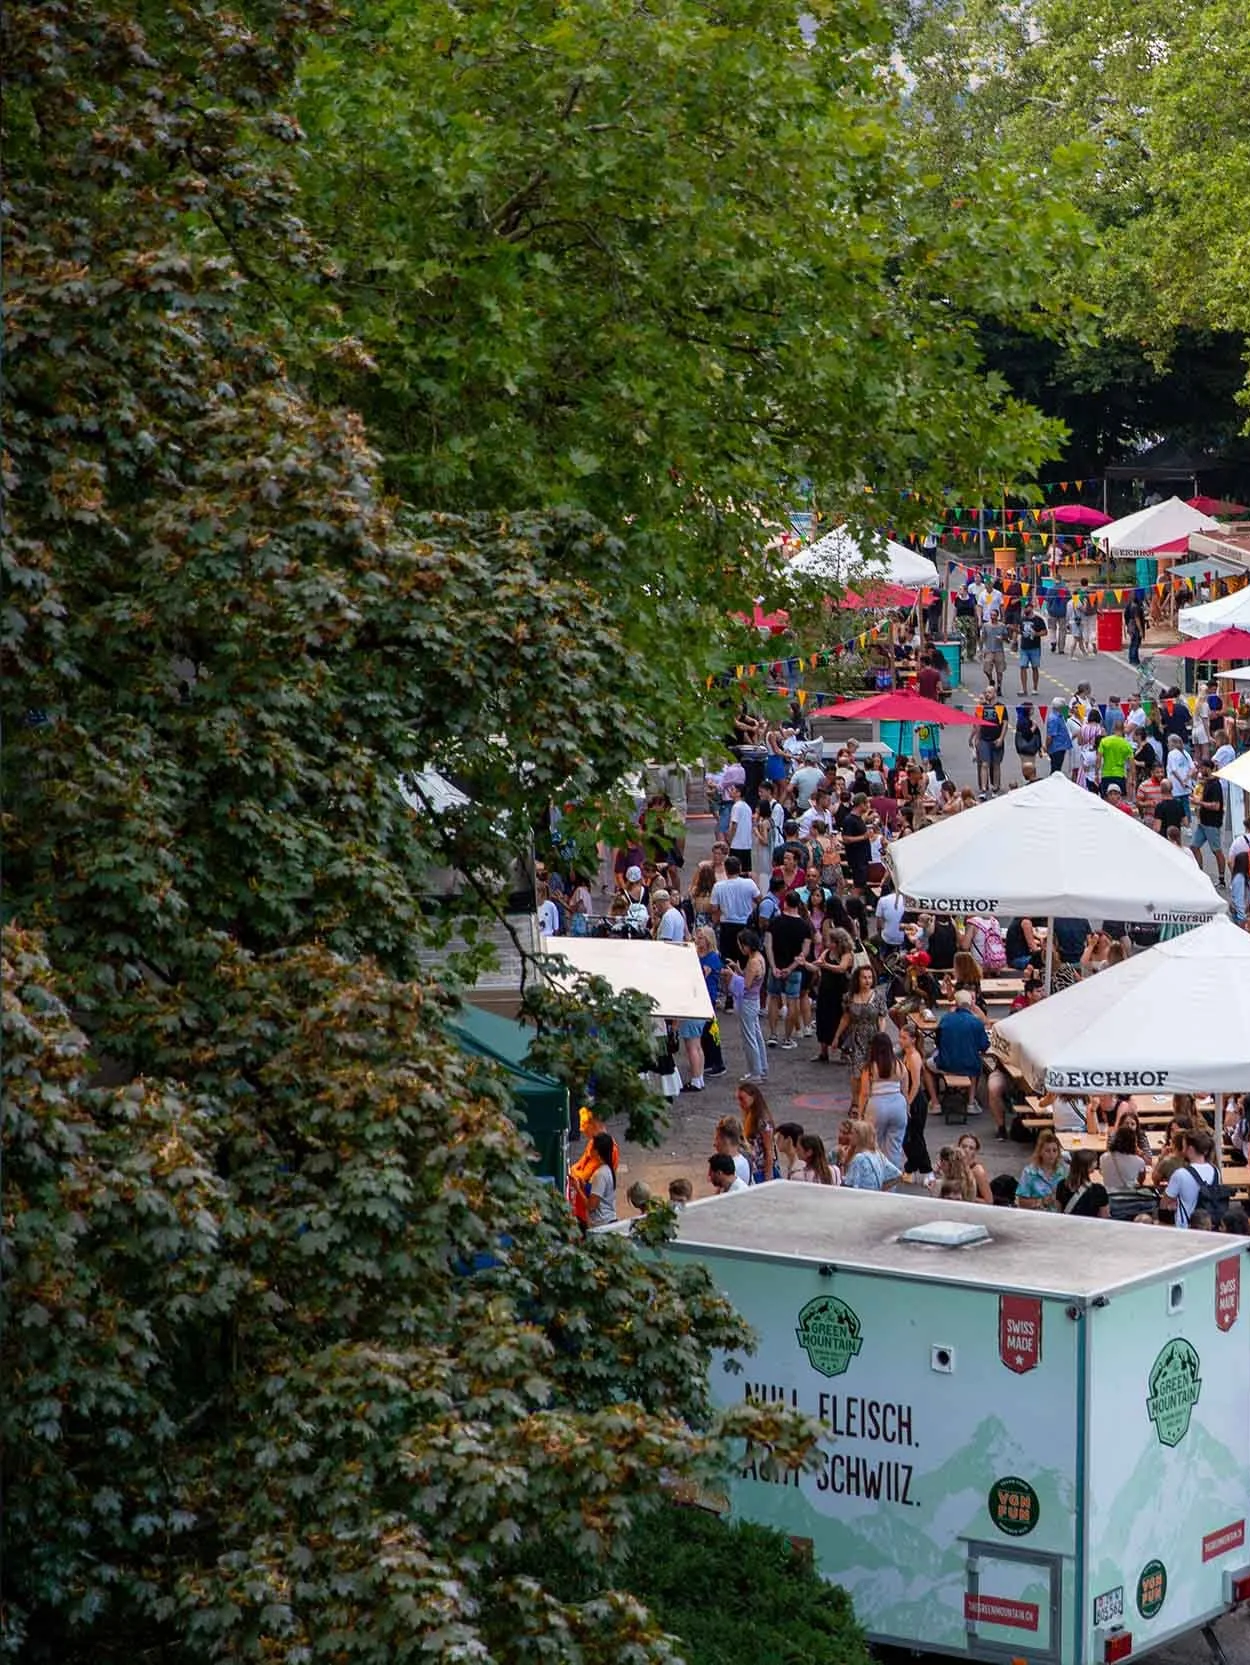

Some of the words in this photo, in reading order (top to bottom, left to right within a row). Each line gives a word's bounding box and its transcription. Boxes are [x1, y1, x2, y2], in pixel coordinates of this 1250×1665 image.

[919, 898, 999, 912] EICHHOF
[1067, 1071, 1169, 1088] EICHHOF
[811, 1323, 848, 1337] GREEN
[1007, 1318, 1035, 1335] SWISS
[802, 1333, 857, 1351] MOUNTAIN
[1007, 1335, 1033, 1352] MADE
[1160, 1374, 1190, 1397] GREEN
[1151, 1384, 1197, 1416] MOUNTAIN
[819, 1392, 919, 1448] FLEISCH.
[816, 1451, 921, 1507] SCHWIIZ.
